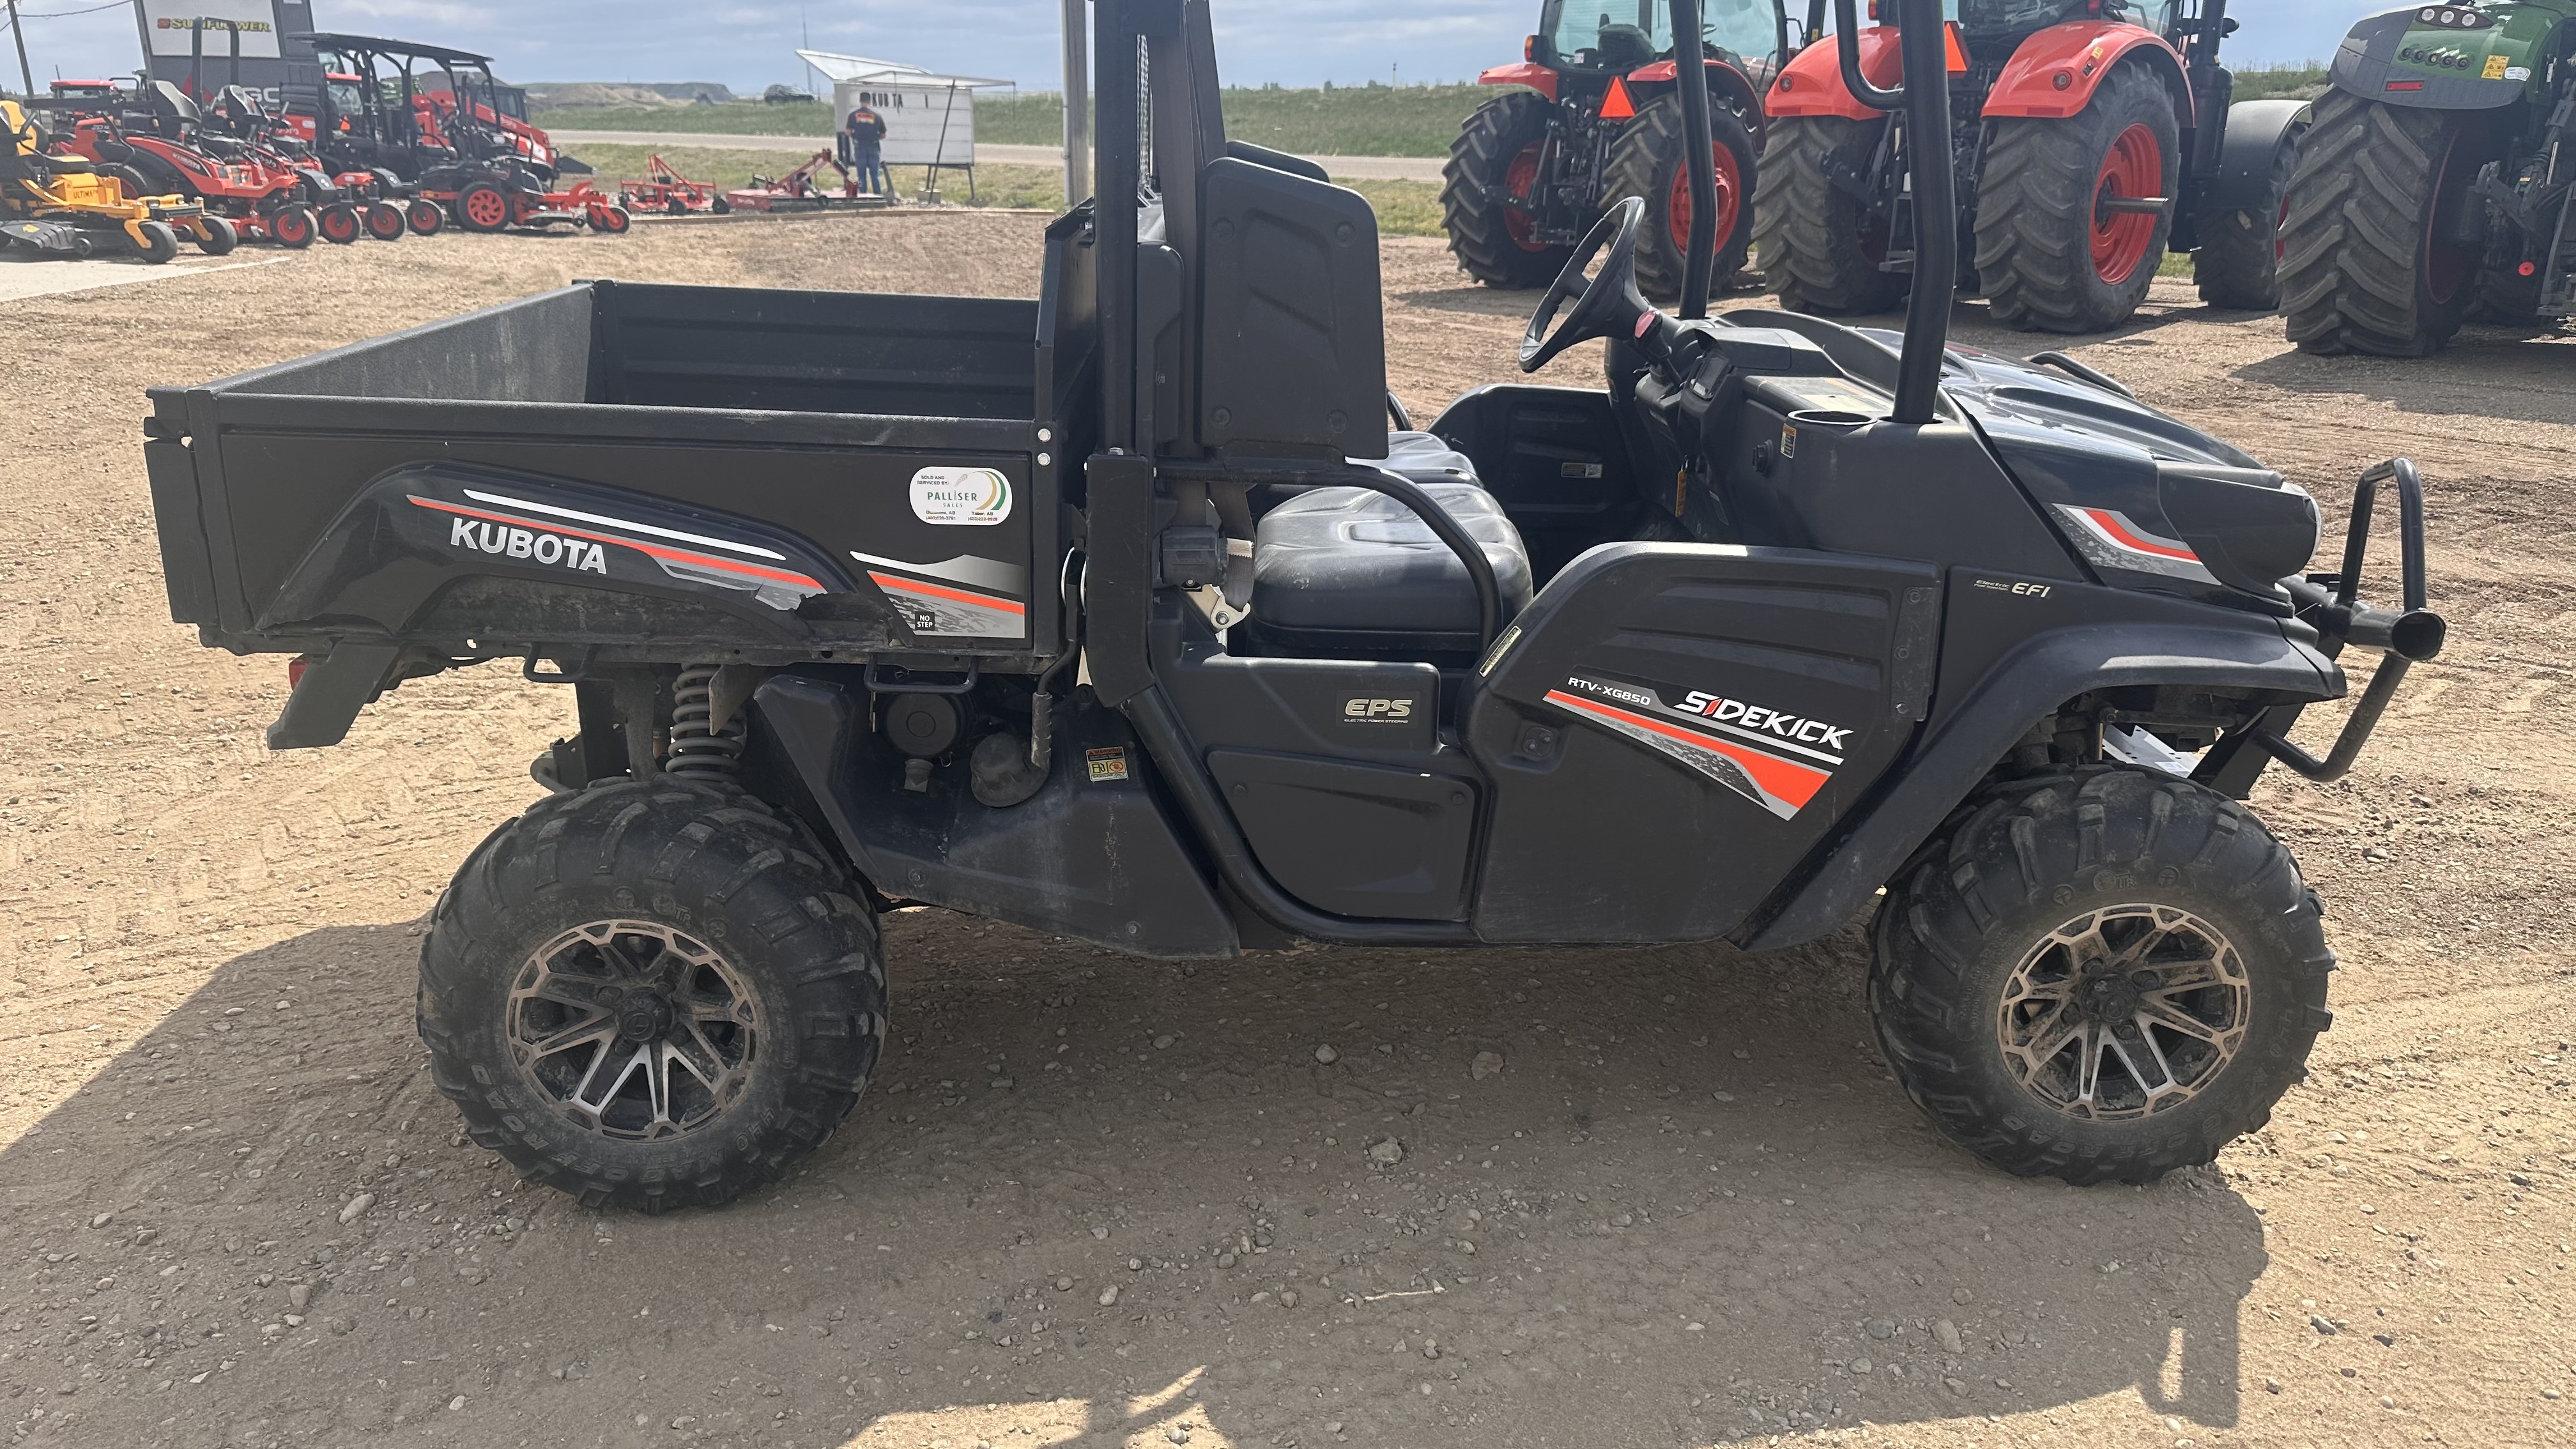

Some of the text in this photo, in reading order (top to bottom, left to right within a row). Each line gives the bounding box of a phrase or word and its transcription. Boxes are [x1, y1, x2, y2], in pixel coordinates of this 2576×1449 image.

[73, 190, 93, 199] ULTIMA
[927, 490, 977, 502] PALLISER
[450, 517, 607, 574] KUBOTA
[1976, 579, 2051, 597] Electric EFI
[1568, 677, 1651, 705] RTV-XG850
[1345, 699, 1413, 717] EPS
[1673, 691, 1854, 750] SIDEKICK
